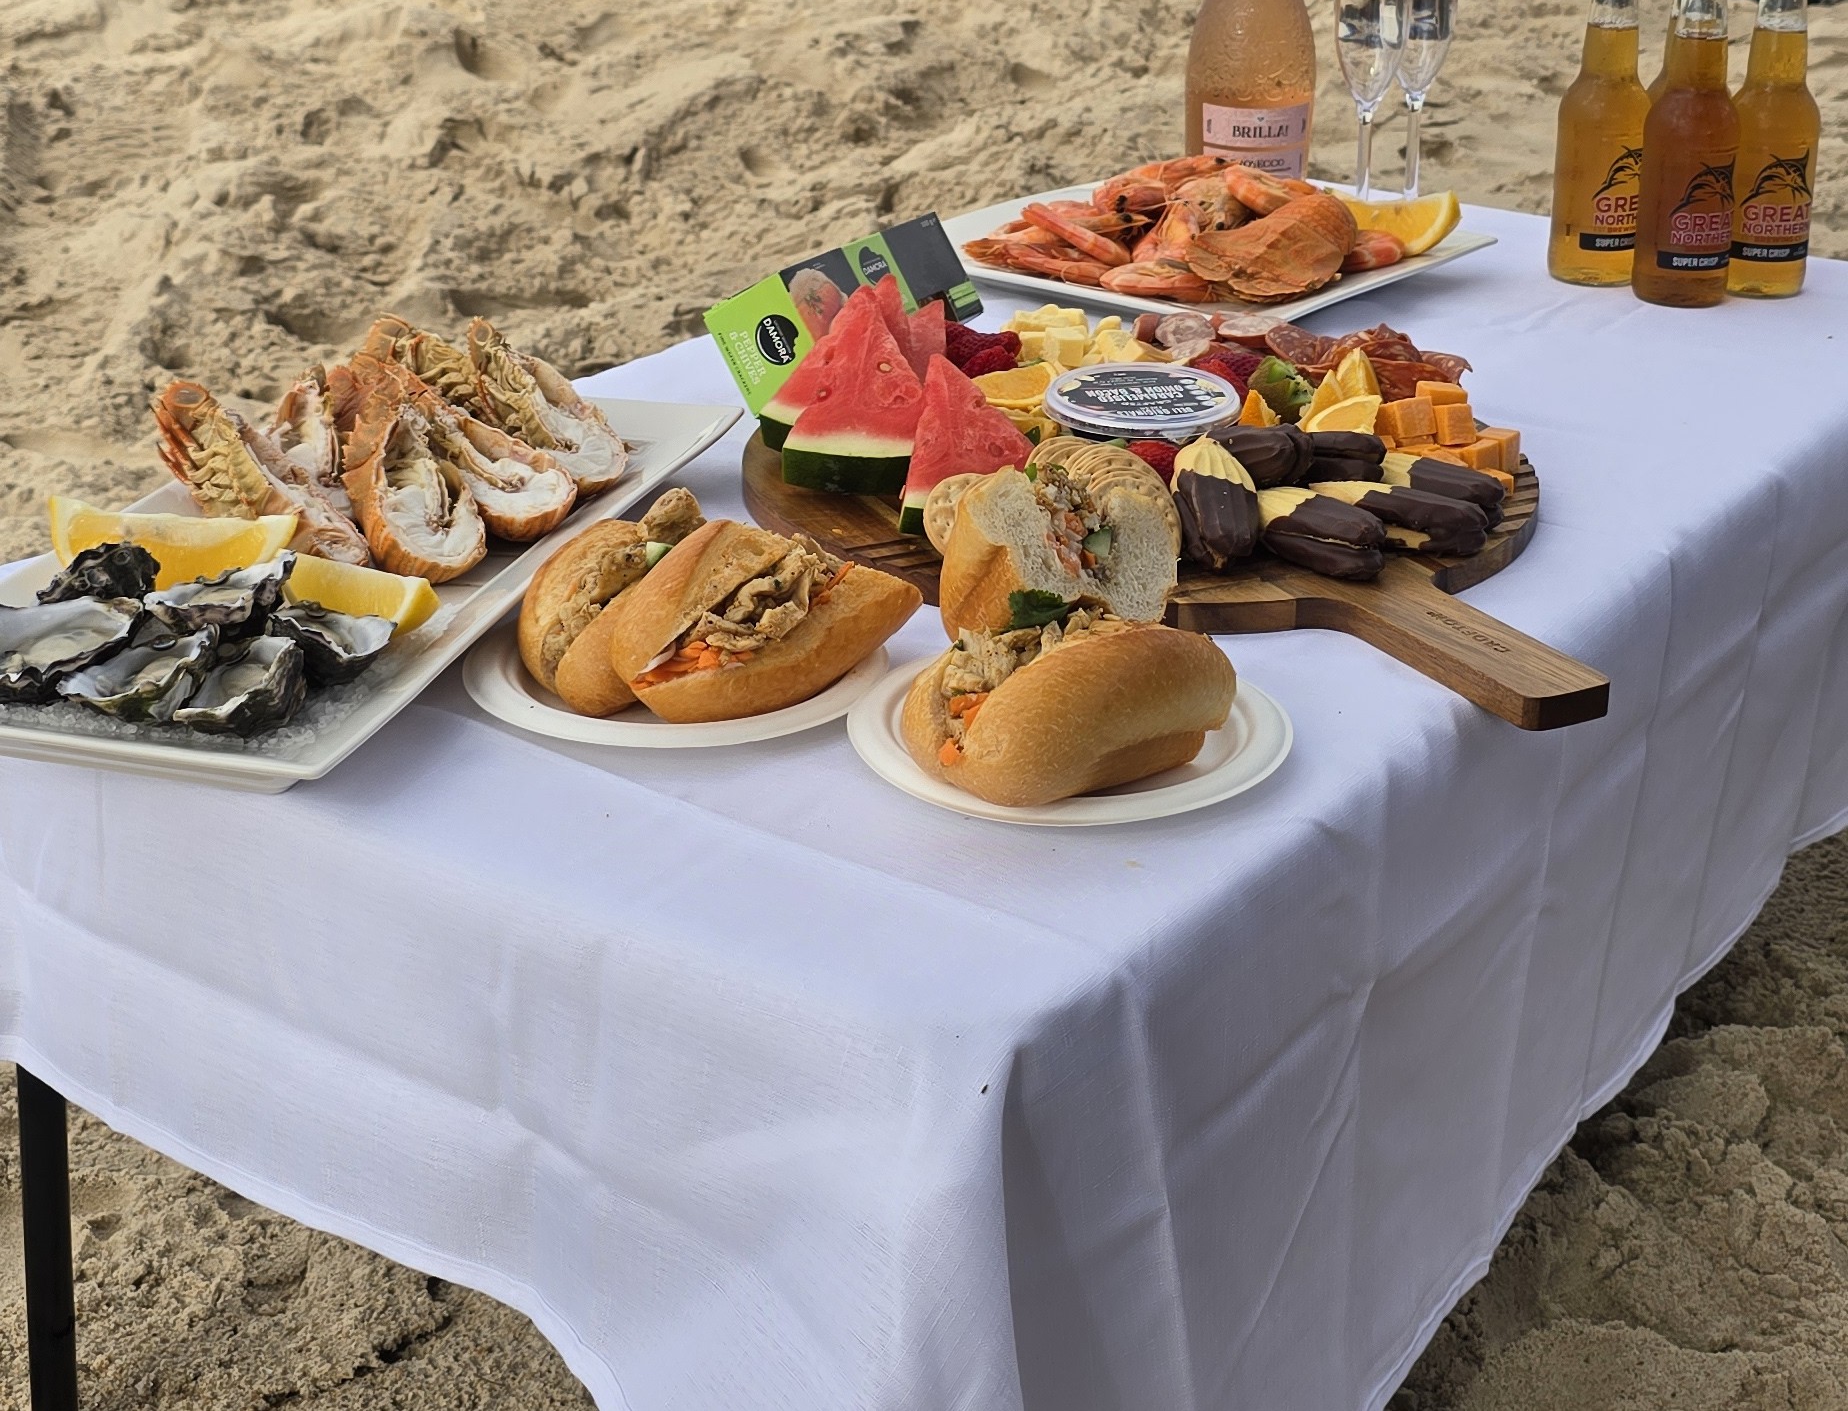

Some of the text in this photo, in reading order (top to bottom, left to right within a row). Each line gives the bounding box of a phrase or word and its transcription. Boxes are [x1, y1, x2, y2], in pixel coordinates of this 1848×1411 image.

[1232, 125, 1289, 139] BRILLA!
[1595, 195, 1639, 213] GRE
[1672, 212, 1733, 231] GREA
[1672, 256, 1698, 267] SUPER
[739, 330, 767, 377] PEPPER
[734, 341, 761, 385] CHIVES
[1097, 391, 1184, 403] CARAMELISED
[1143, 384, 1184, 395] ONION
